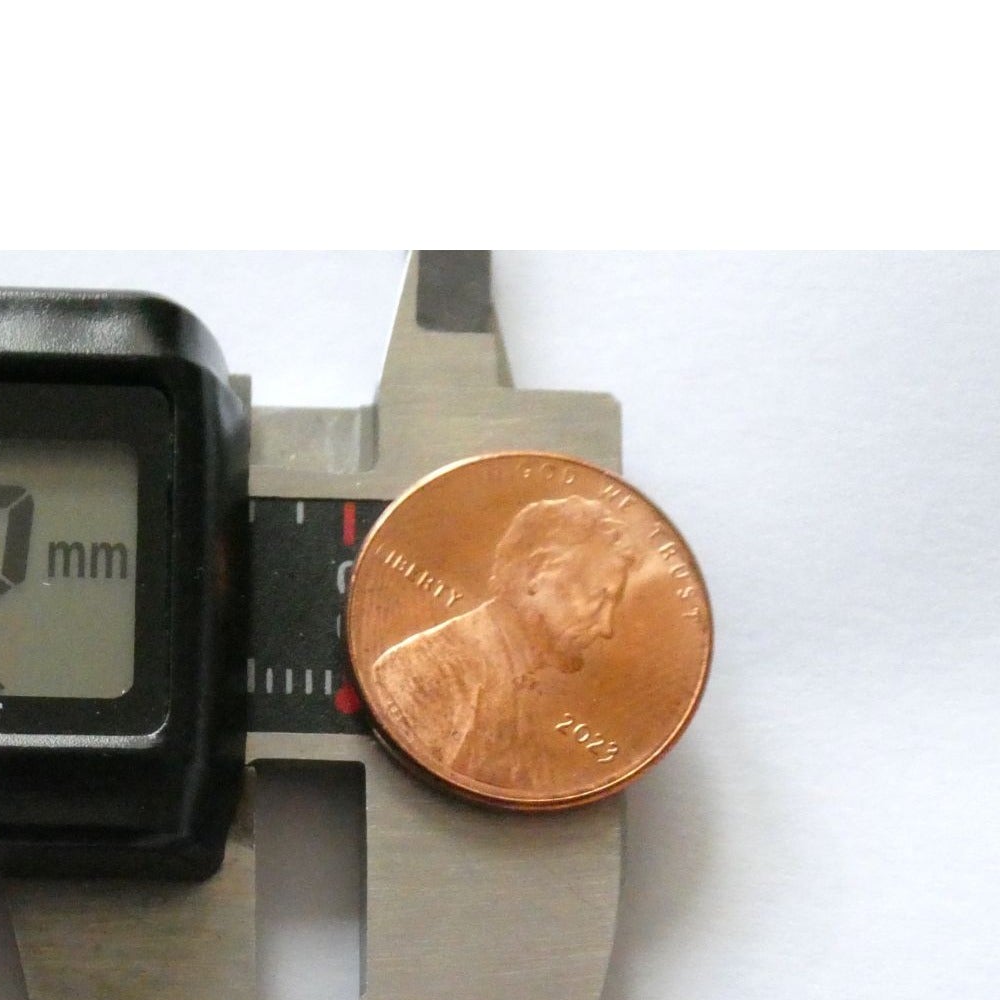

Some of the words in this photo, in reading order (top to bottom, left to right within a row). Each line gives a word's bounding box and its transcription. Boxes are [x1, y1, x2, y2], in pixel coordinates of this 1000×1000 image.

[47, 540, 129, 579] mm
[375, 543, 463, 607] LIBERTY
[650, 521, 699, 622] TRUST
[554, 711, 618, 763] 2023
